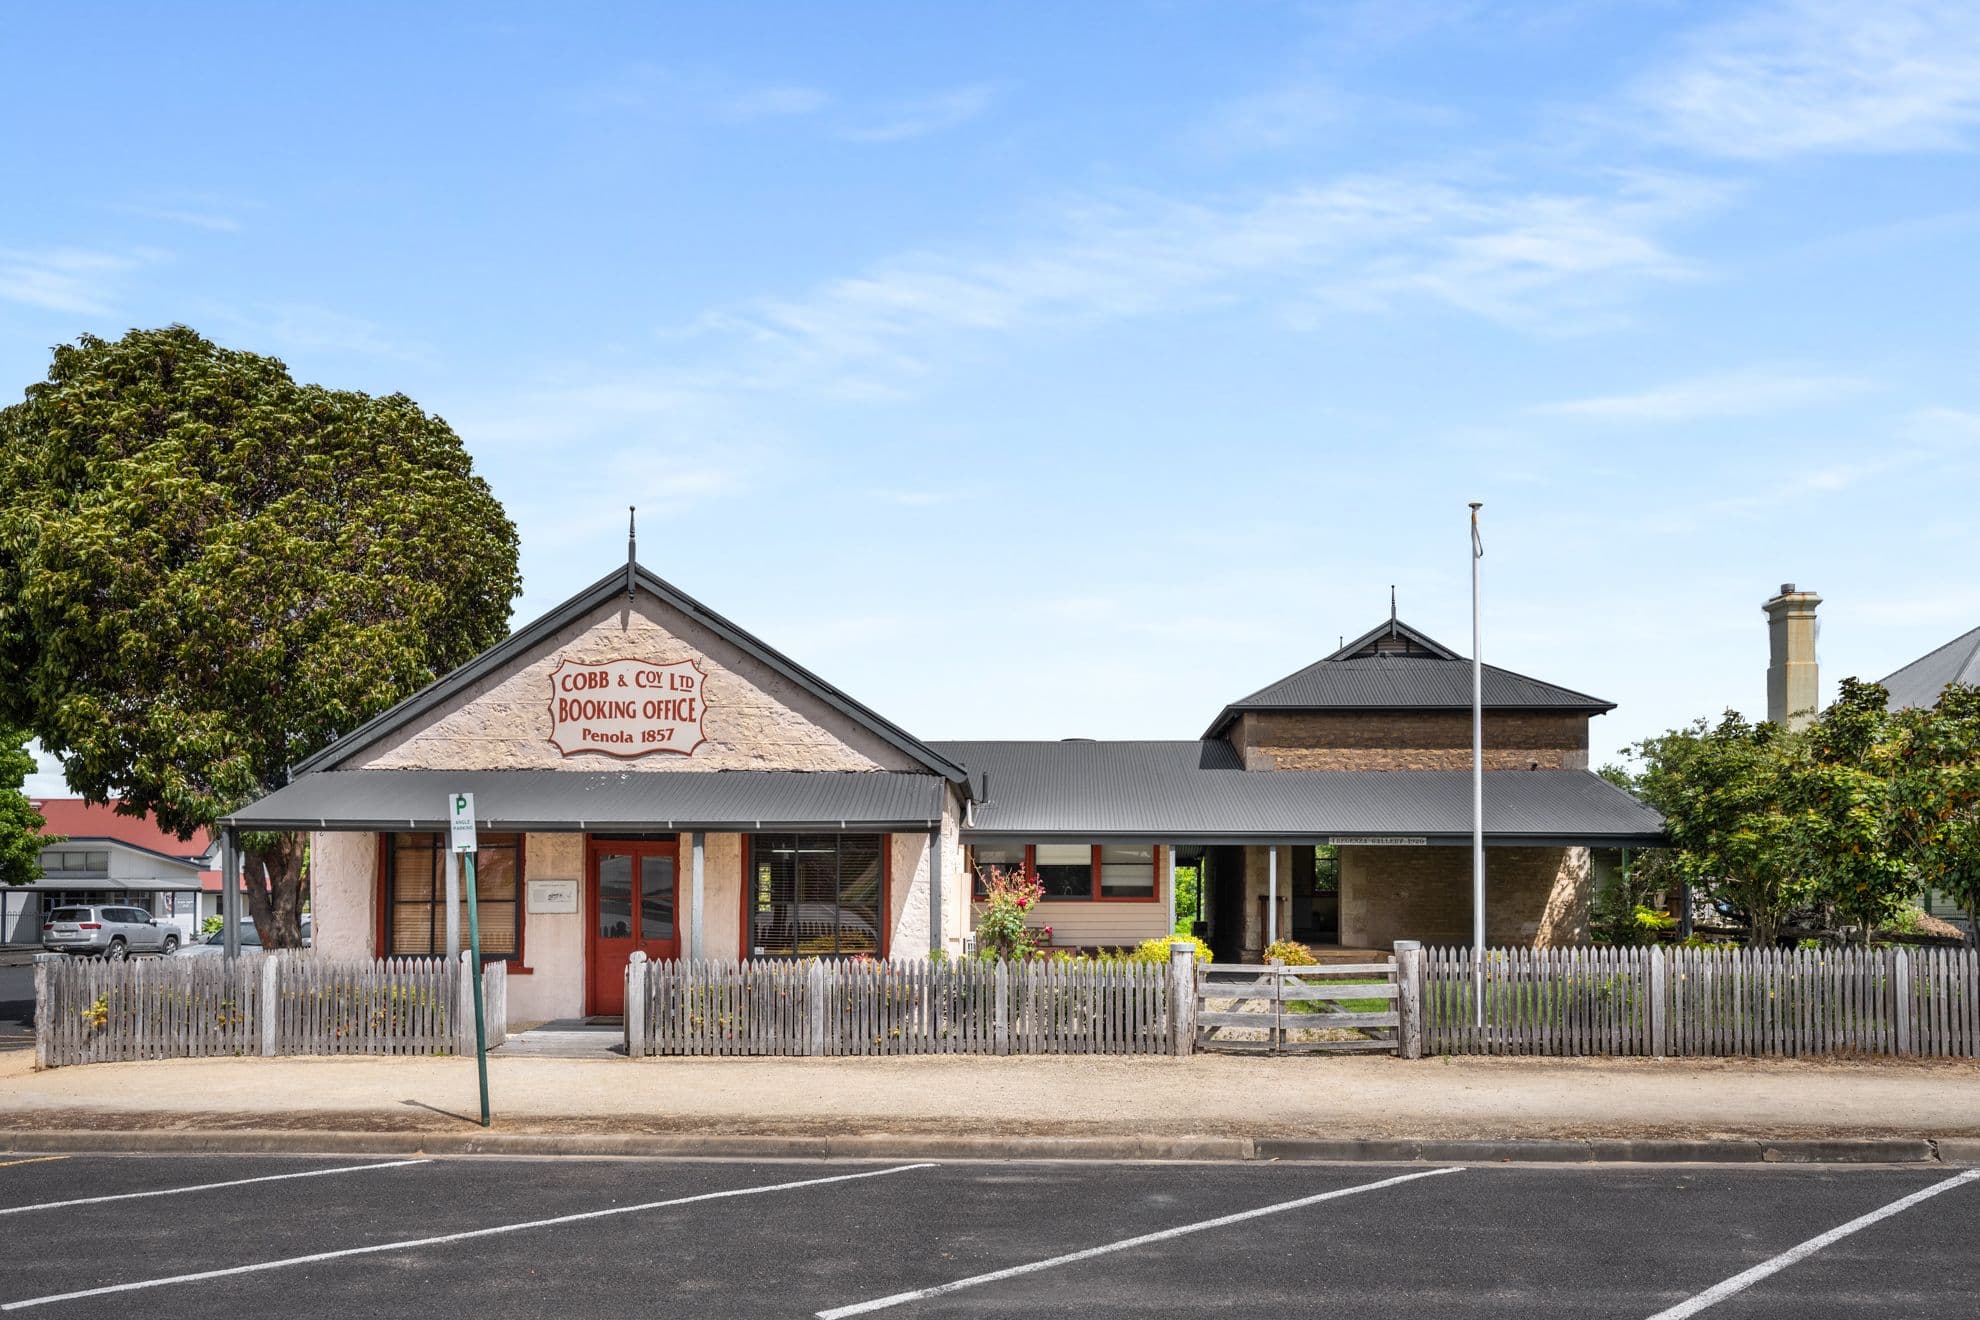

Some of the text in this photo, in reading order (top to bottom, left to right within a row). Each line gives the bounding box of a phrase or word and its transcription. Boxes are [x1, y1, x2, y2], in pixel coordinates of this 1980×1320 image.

[561, 671, 609, 692] COBB
[617, 674, 628, 687] &
[558, 697, 697, 723] BOOKING OFFICE
[582, 728, 675, 743] Penola 1857
[456, 797, 467, 815] P
